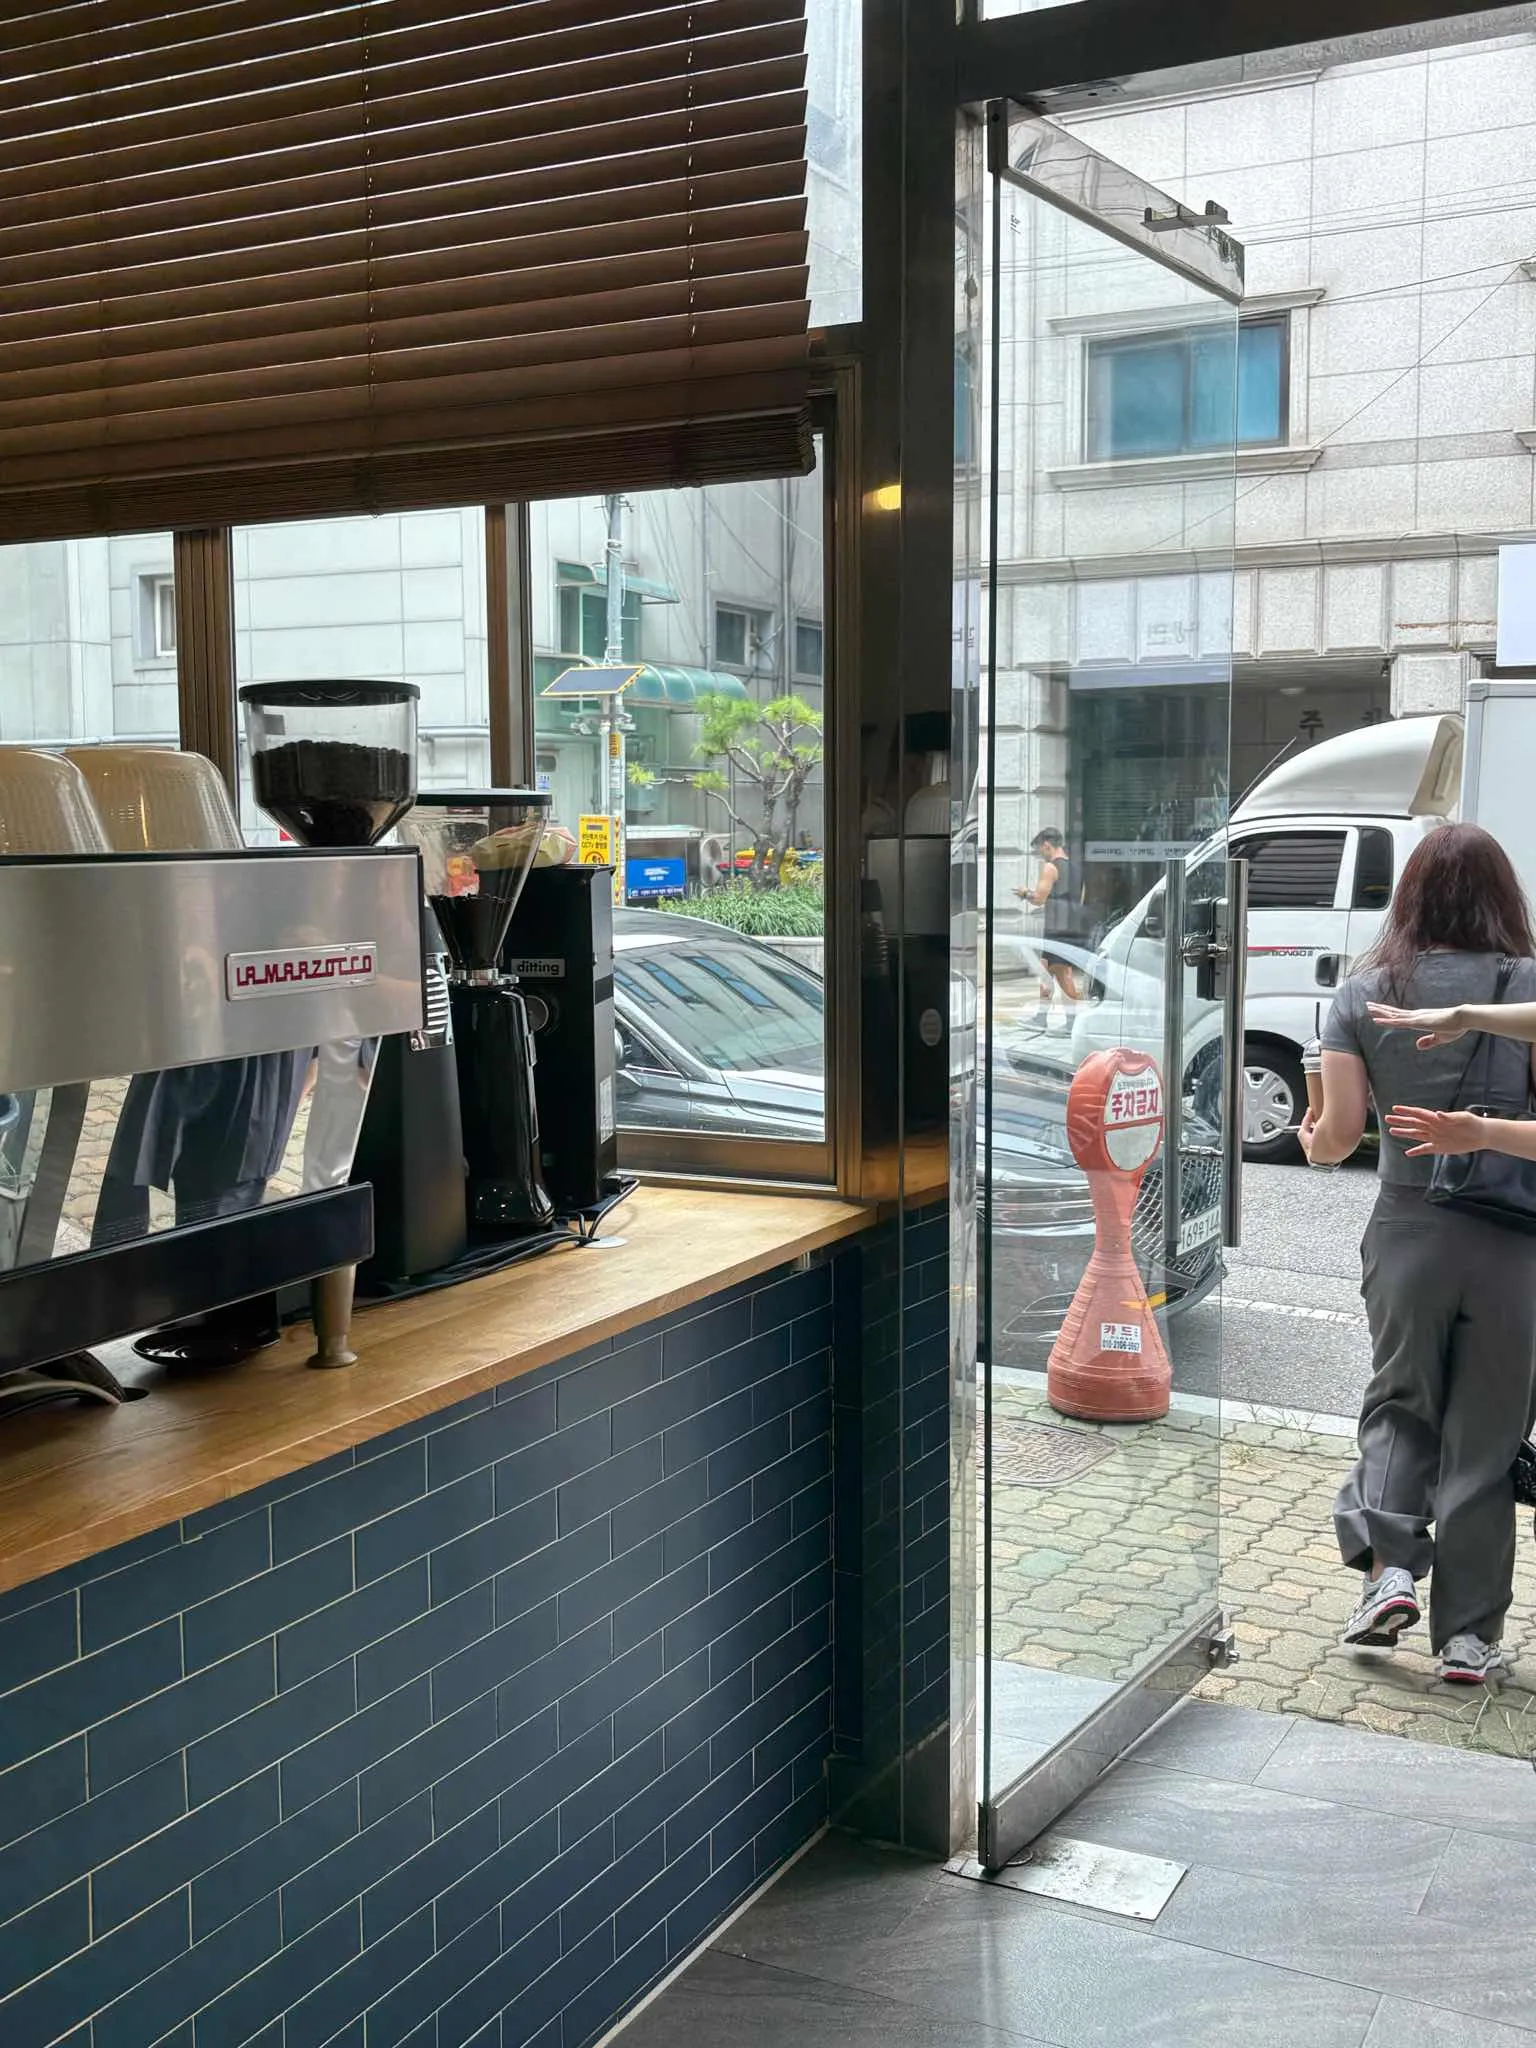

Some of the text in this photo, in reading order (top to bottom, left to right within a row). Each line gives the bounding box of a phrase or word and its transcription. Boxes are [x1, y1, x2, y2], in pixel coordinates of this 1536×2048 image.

[236, 954, 372, 987] LA MARZOCCO
[516, 960, 560, 976] ditting
[1111, 1087, 1158, 1120] 주차금지
